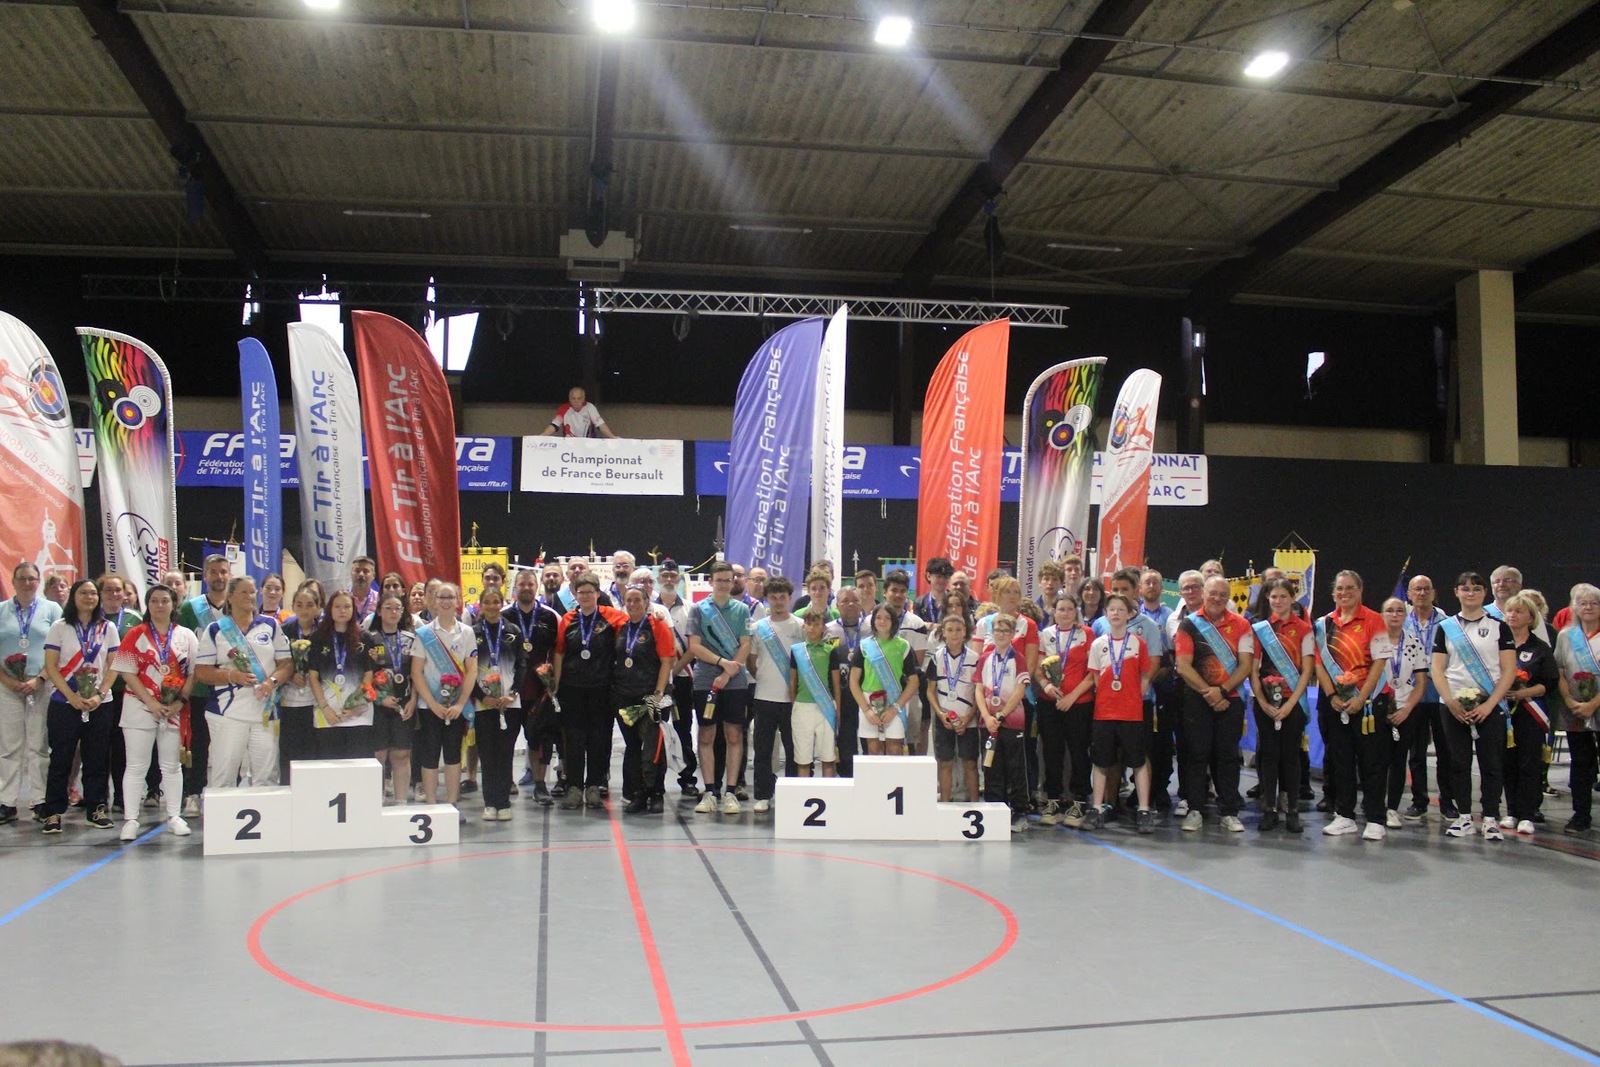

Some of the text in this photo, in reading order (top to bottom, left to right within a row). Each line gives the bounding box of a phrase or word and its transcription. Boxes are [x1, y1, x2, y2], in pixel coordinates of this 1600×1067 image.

[249, 381, 261, 445] l'Arc
[329, 409, 337, 424] Tir
[411, 407, 421, 423] Tir
[760, 347, 782, 453] Française
[330, 427, 338, 441] de
[414, 426, 424, 440] de
[309, 370, 336, 562] FF Tir à l'Arc
[331, 445, 341, 500] Française
[384, 363, 423, 565] FF Tir à l'Arc
[541, 466, 664, 480] de France Beursault
[560, 452, 643, 467] Championnat
[945, 351, 970, 566] édération Française
[251, 479, 265, 520] Tir
[767, 445, 790, 577] de Tir à l'Arc
[962, 447, 981, 580] de Tir à l'Arc
[106, 512, 116, 573] ralarcidf.com
[251, 527, 265, 570] FF
[335, 503, 345, 564] Fédération
[1025, 536, 1035, 599] iralarcidf.com
[328, 792, 347, 824] 1
[802, 797, 827, 827] 2
[886, 786, 904, 816] 1
[234, 808, 262, 841] 2
[408, 813, 434, 844] 3
[961, 809, 985, 839] 3
